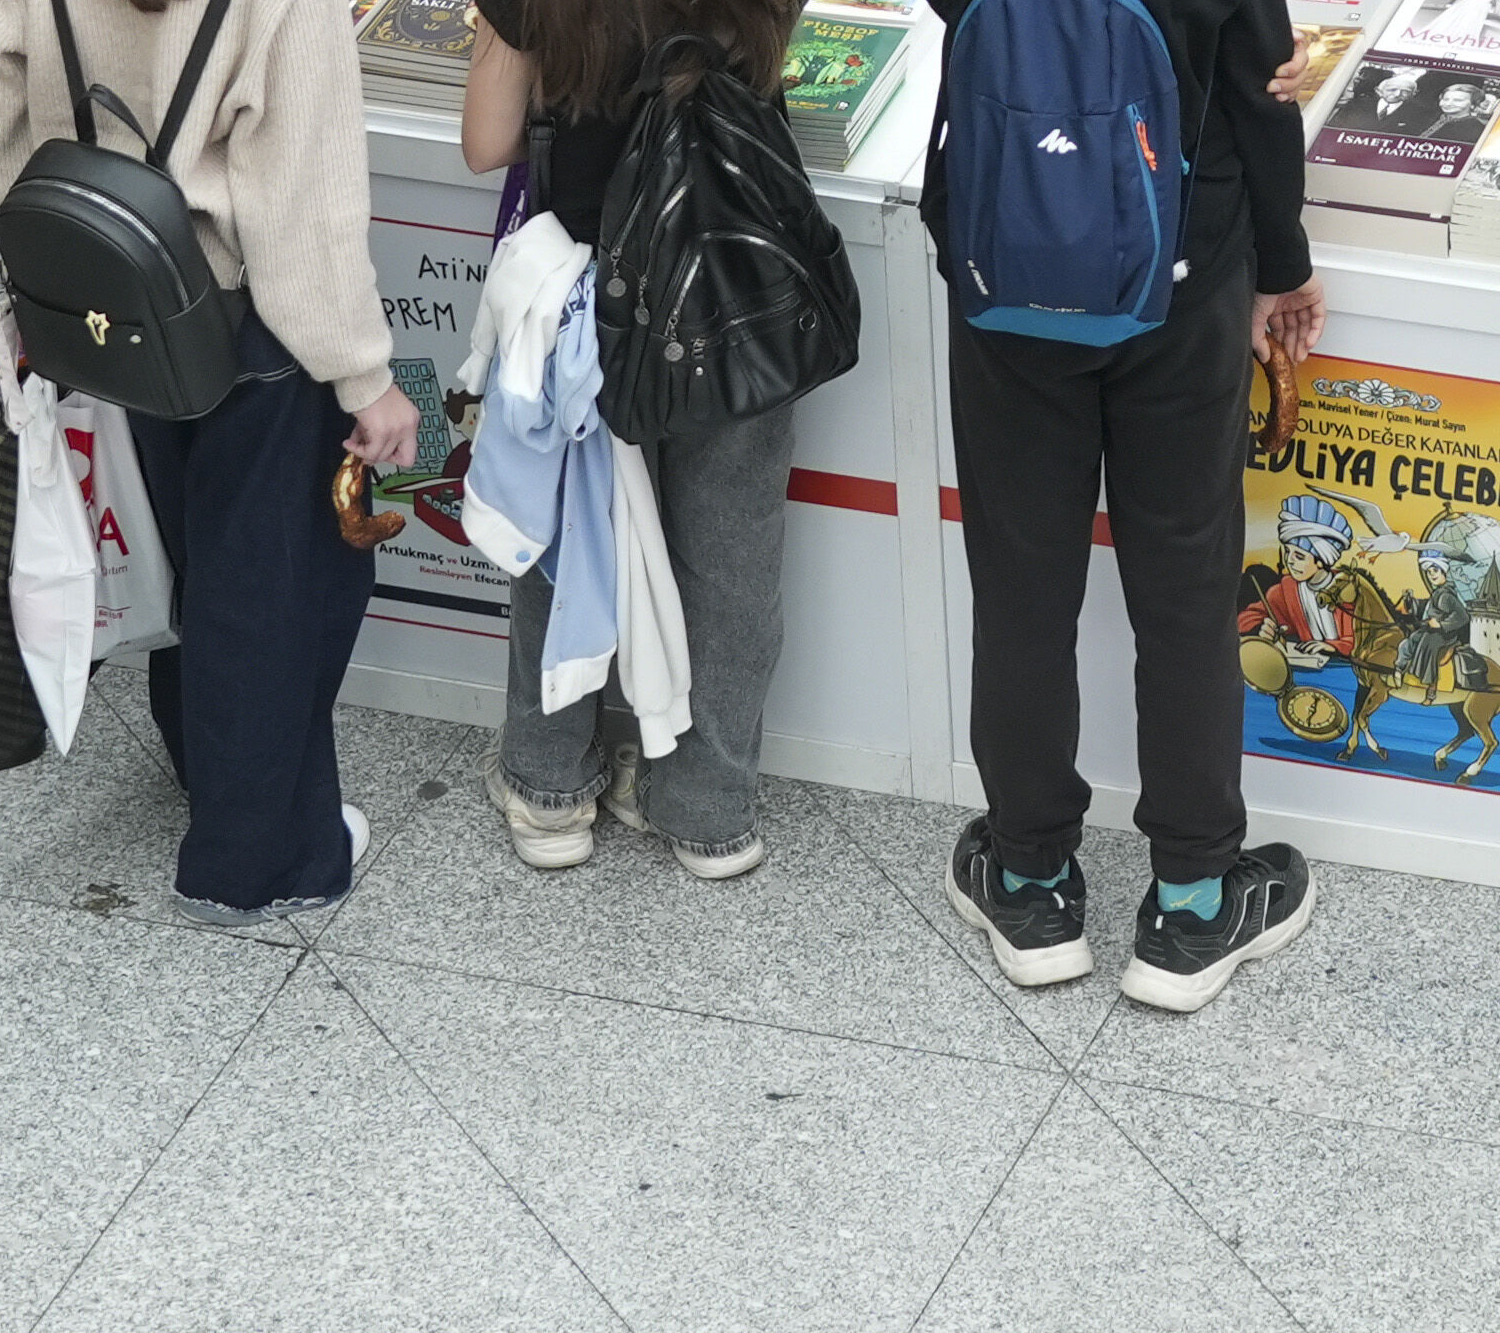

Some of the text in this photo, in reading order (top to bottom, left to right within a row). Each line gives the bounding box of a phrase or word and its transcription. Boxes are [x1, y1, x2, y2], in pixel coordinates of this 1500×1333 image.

[1337, 131, 1463, 155] İSMET İNÖNÜ
[1378, 146, 1456, 162] HATIRALAR
[1317, 399, 1352, 418] Mavisel
[1353, 405, 1379, 420] Yener
[1414, 414, 1440, 429] Murat
[1442, 418, 1466, 433] Sayın
[1358, 425, 1417, 450] DEĞER
[379, 543, 495, 571] Artukmaç Uzm.
[474, 573, 510, 586] Efecan
